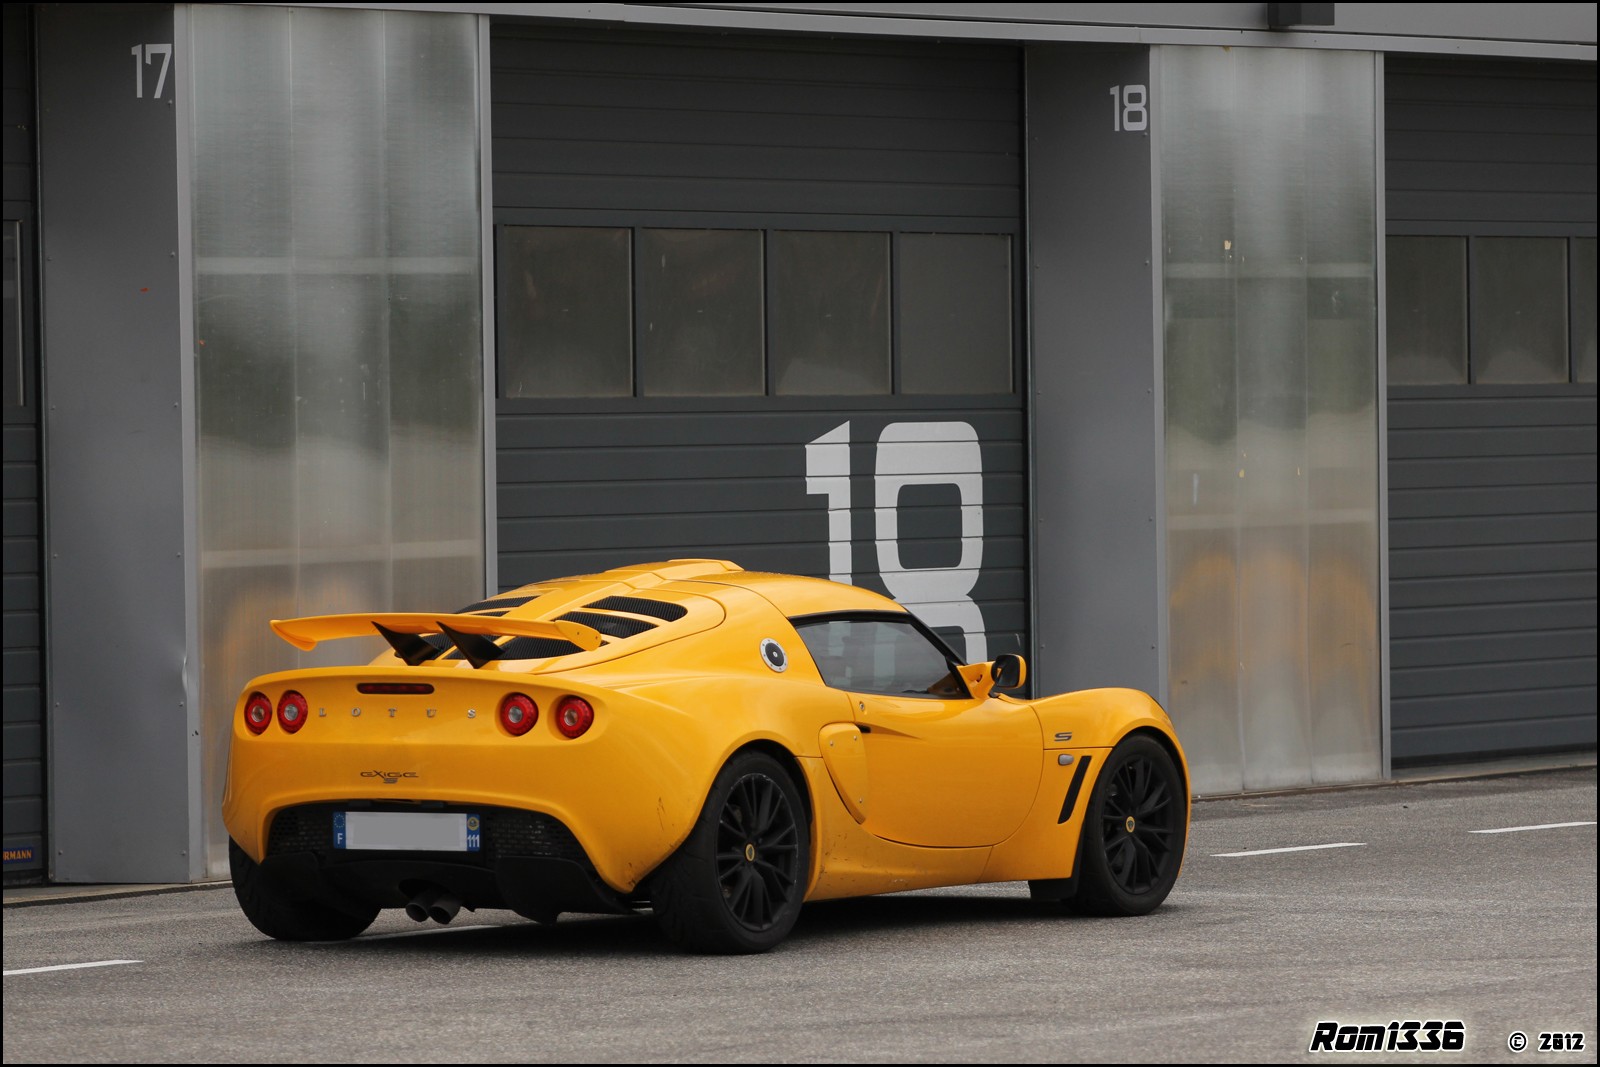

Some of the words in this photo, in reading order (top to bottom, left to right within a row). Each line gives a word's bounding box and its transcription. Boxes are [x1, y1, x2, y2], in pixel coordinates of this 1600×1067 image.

[131, 43, 172, 99] 17
[1109, 84, 1148, 132] 18
[805, 420, 987, 664] 18
[318, 707, 477, 719] LOTUS
[1054, 732, 1072, 741] S
[337, 832, 343, 844] F
[467, 834, 480, 848] 111
